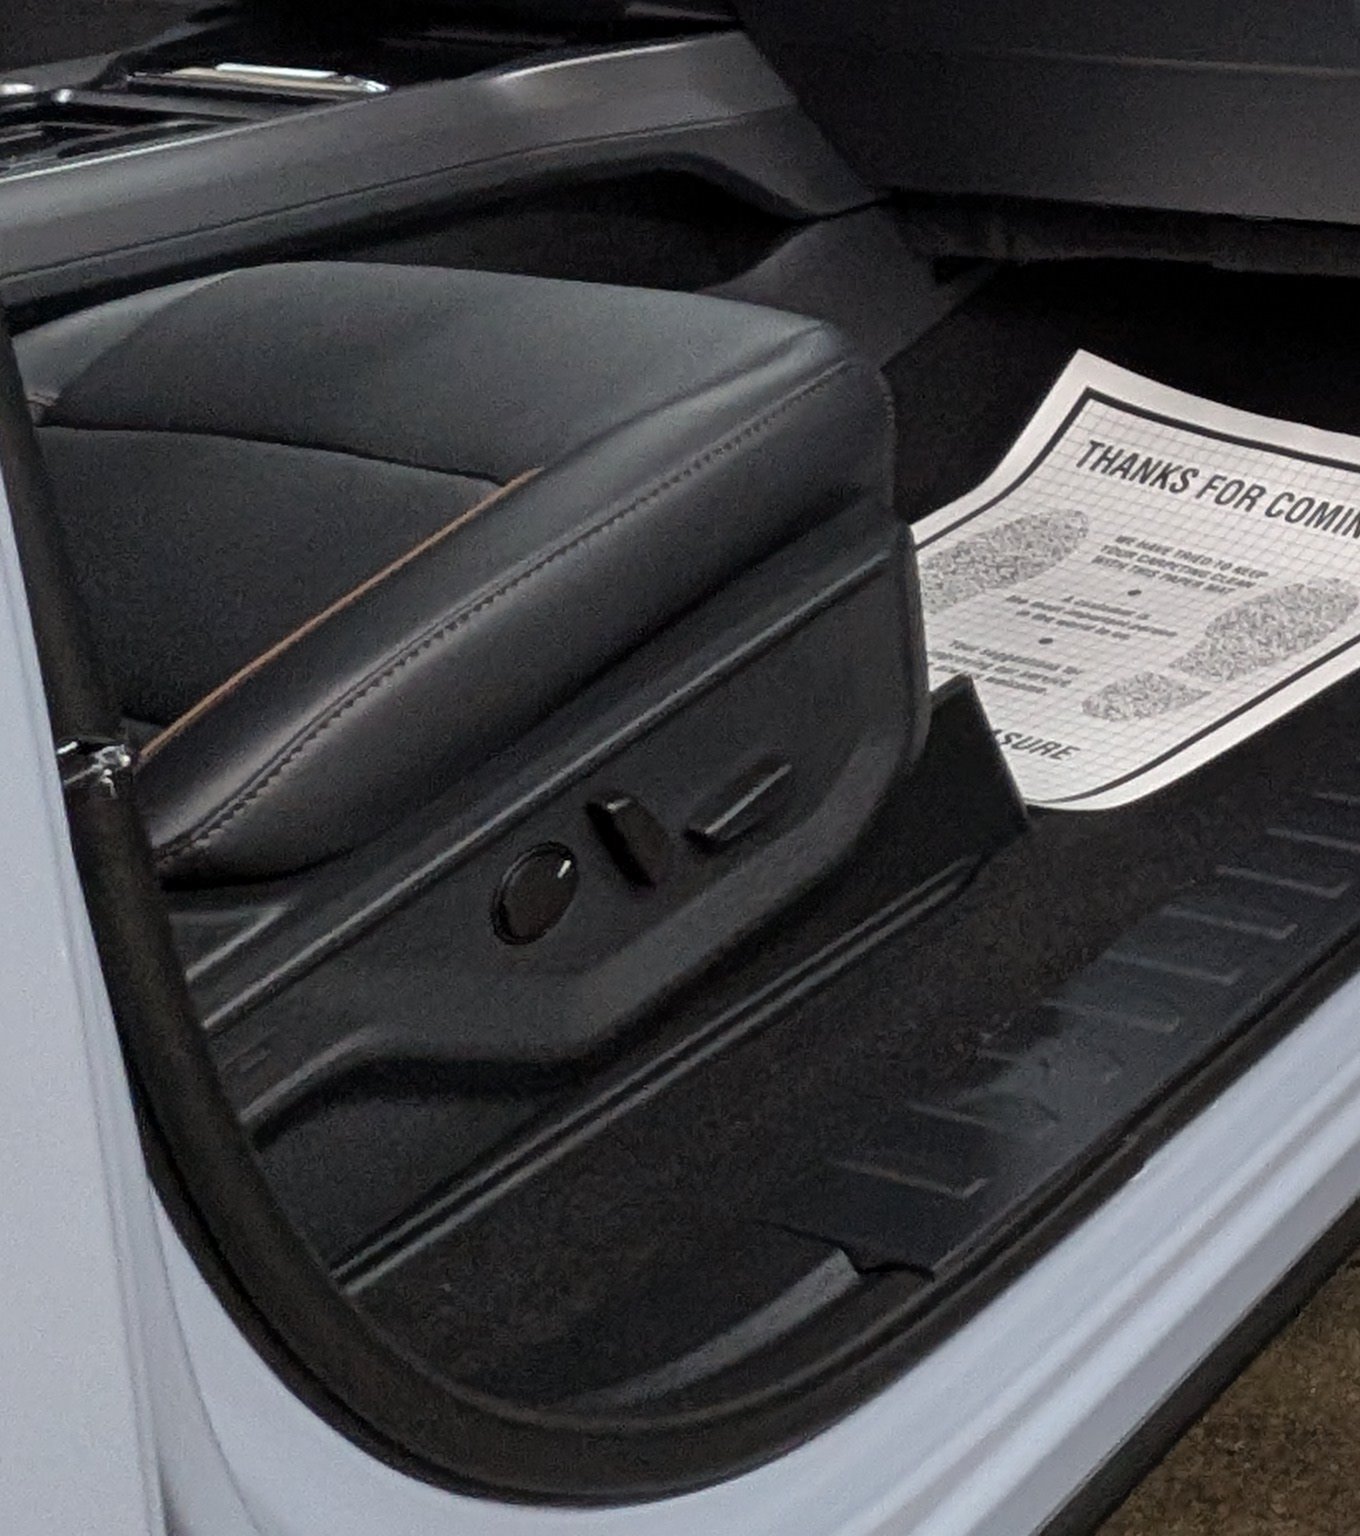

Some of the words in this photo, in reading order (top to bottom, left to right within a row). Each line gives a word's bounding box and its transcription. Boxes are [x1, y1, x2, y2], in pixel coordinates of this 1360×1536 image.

[1075, 440, 1198, 494] THANKS
[1196, 475, 1267, 512] FOR
[1136, 540, 1174, 555] HAVE
[1174, 549, 1213, 565] TRIED
[1213, 559, 1232, 571] TO
[992, 728, 1081, 761] SURE
